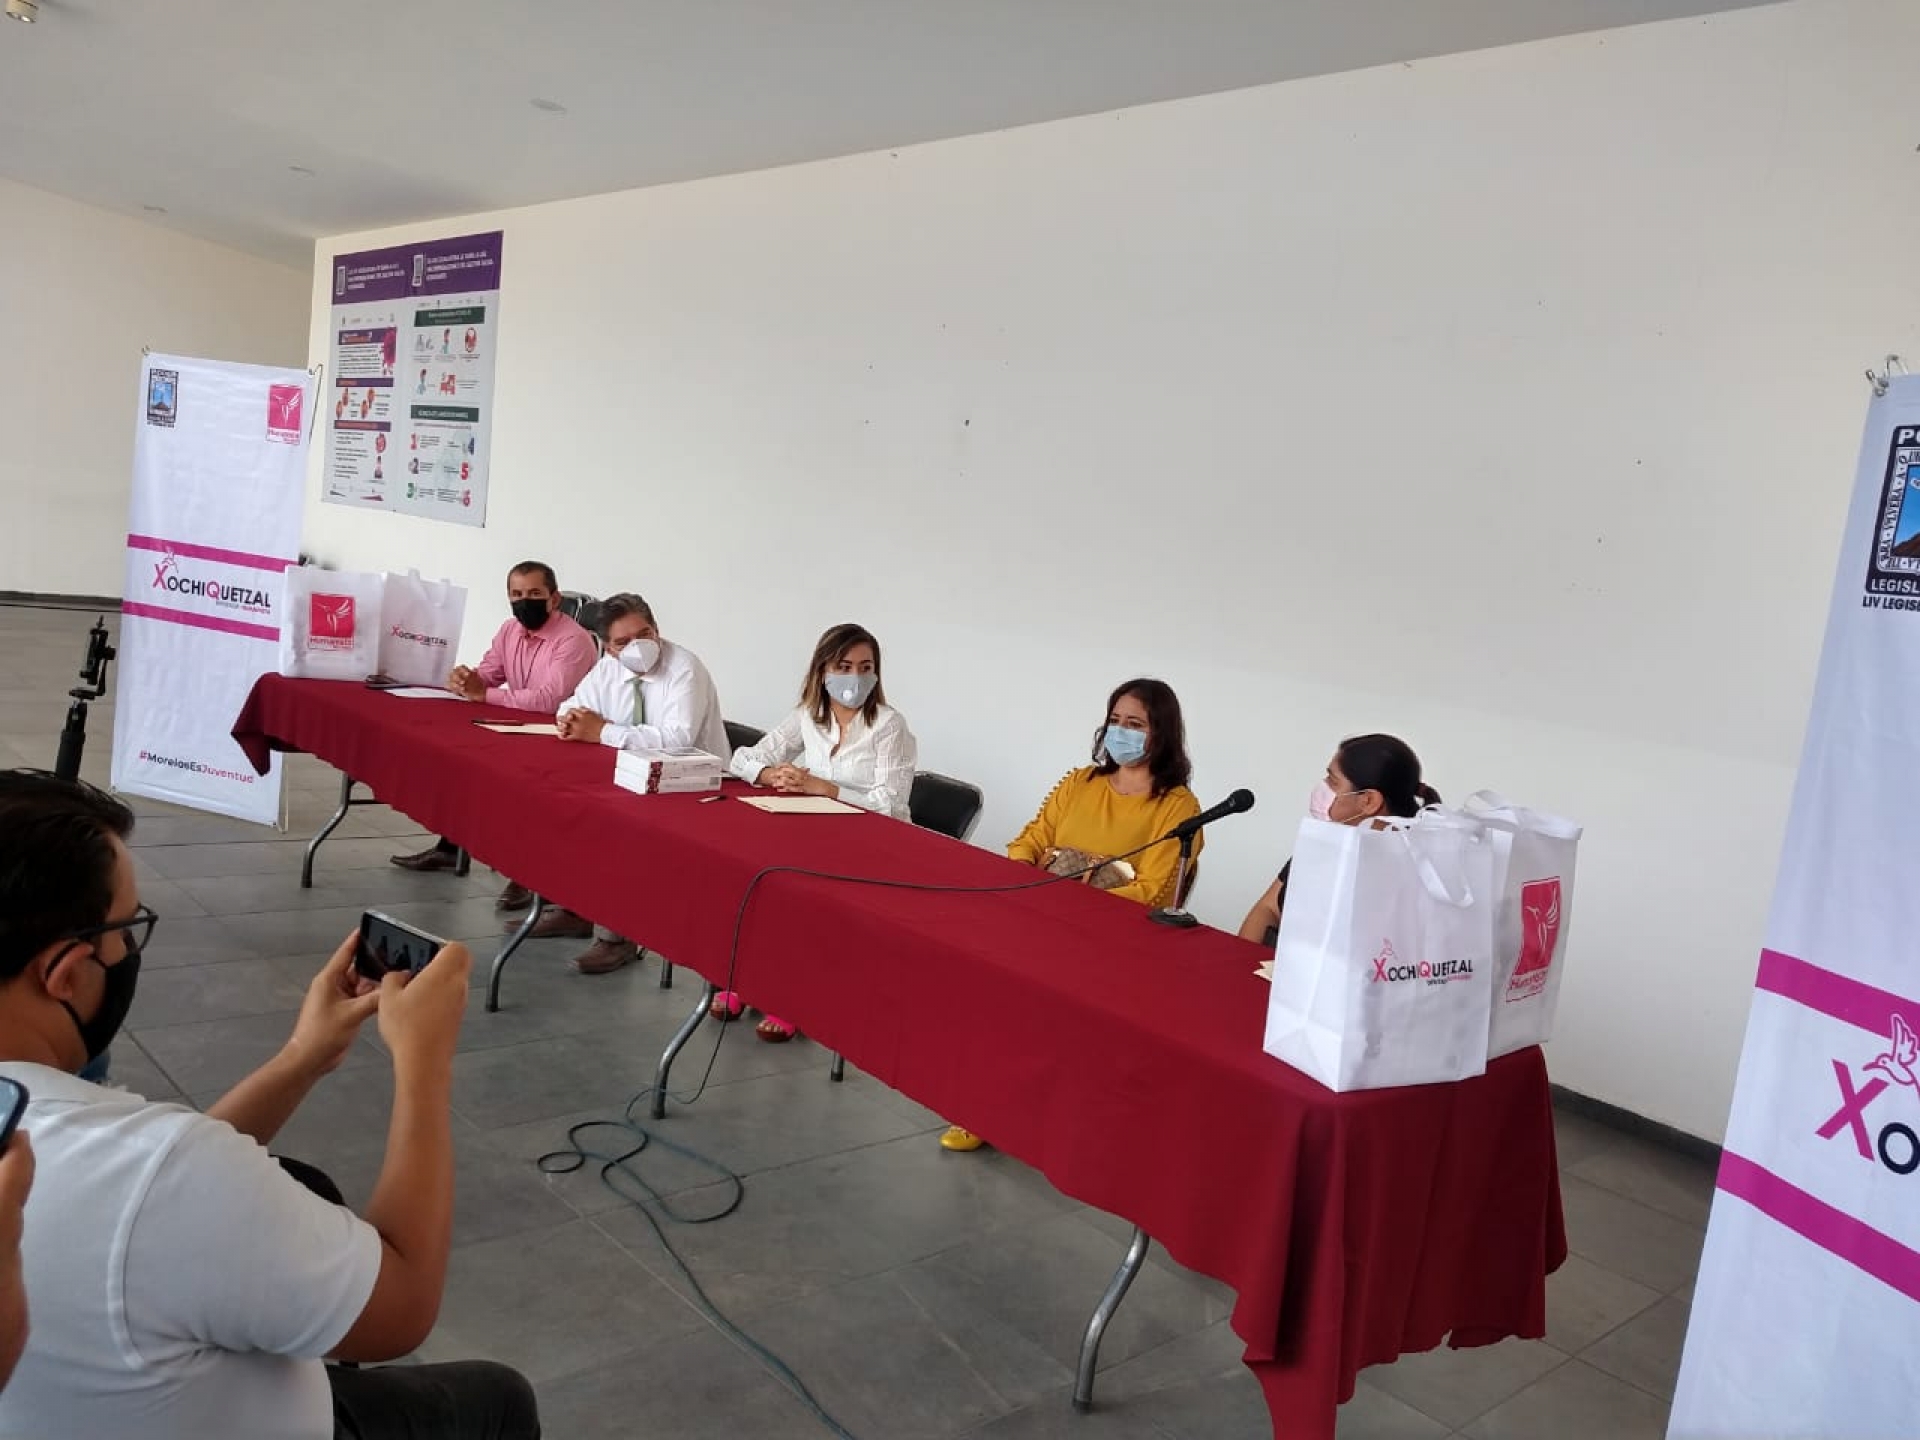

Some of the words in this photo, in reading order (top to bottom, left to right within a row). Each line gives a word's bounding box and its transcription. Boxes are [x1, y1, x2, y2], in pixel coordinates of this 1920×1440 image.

[460, 462, 469, 480] 5
[152, 563, 271, 608] XOCHIQUETZAL
[1862, 595, 1880, 607] LIV
[139, 749, 255, 784] #MorelosEsJuventud
